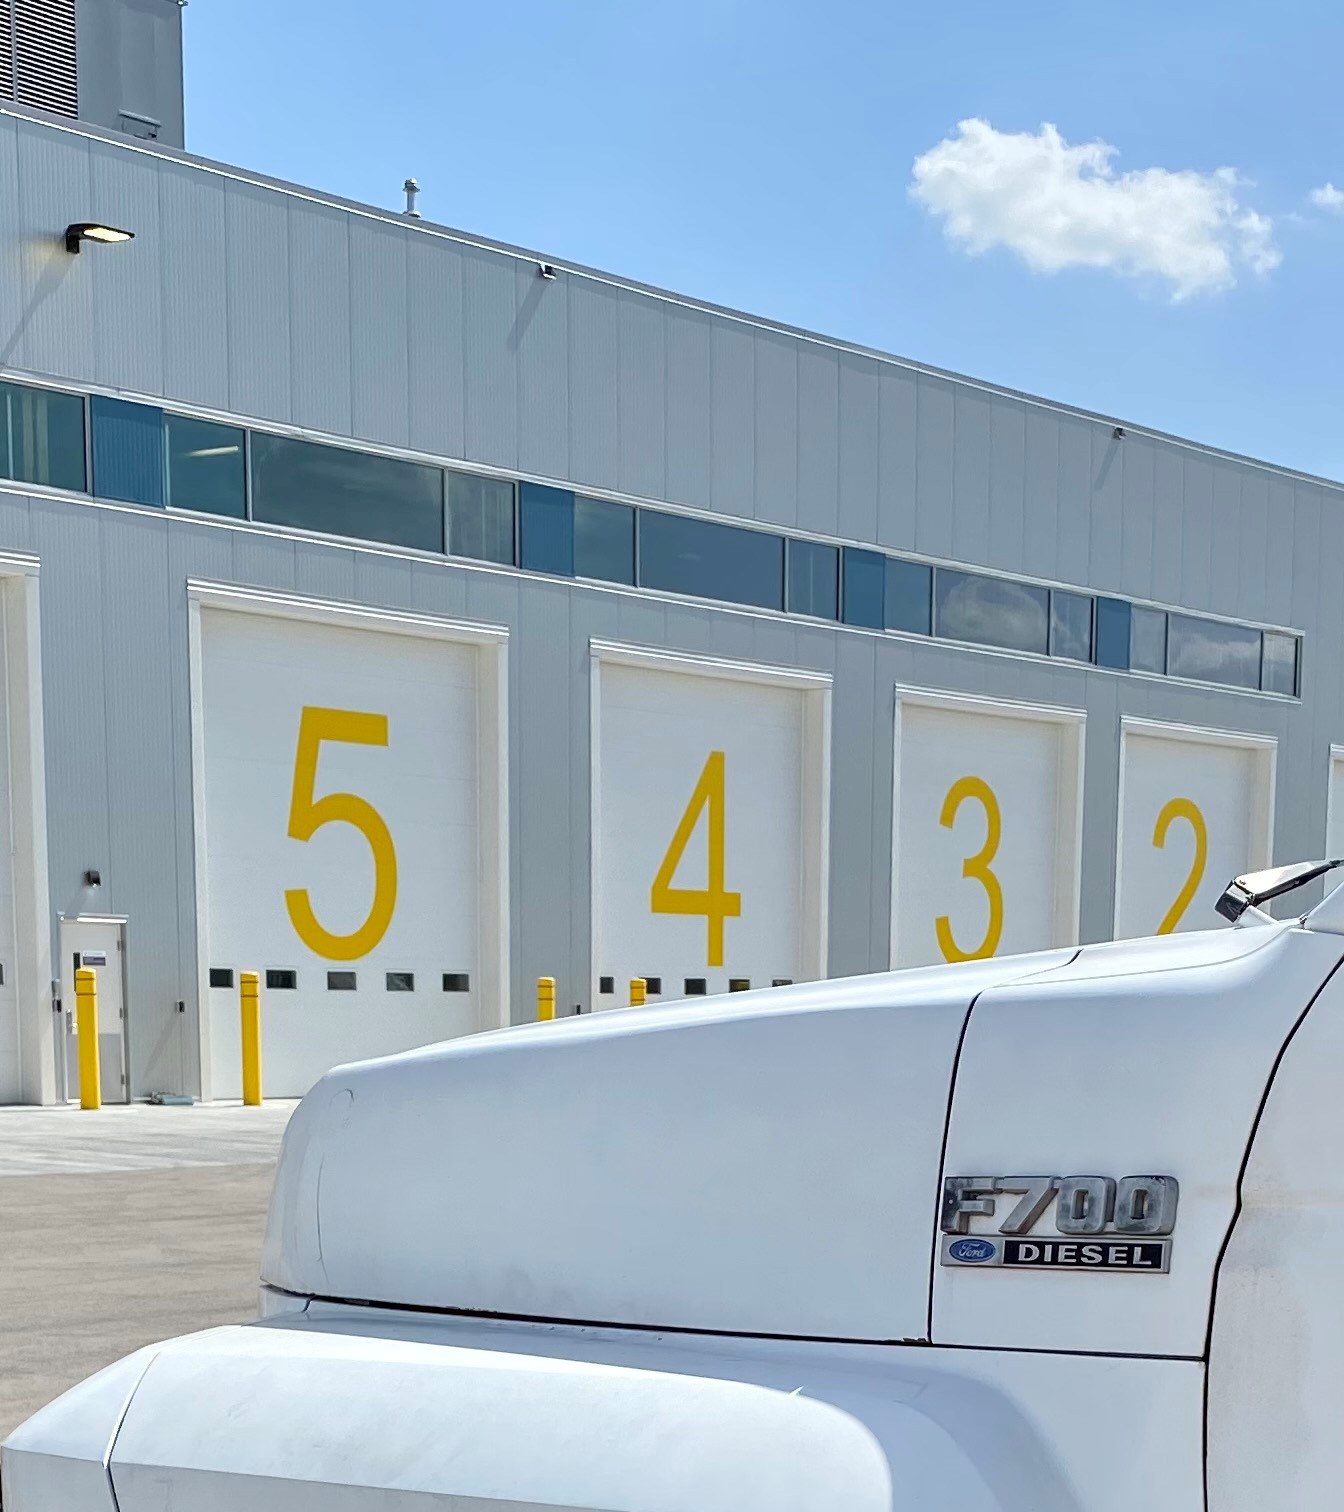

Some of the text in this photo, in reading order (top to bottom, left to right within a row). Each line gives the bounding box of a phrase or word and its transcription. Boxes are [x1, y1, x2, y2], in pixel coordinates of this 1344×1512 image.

[285, 706, 398, 961] 5
[651, 751, 741, 967] 4
[935, 776, 1003, 964] 3
[1152, 797, 1208, 936] 2
[940, 1175, 1179, 1235] F700
[956, 1241, 1153, 1265] Ford DIESEL
